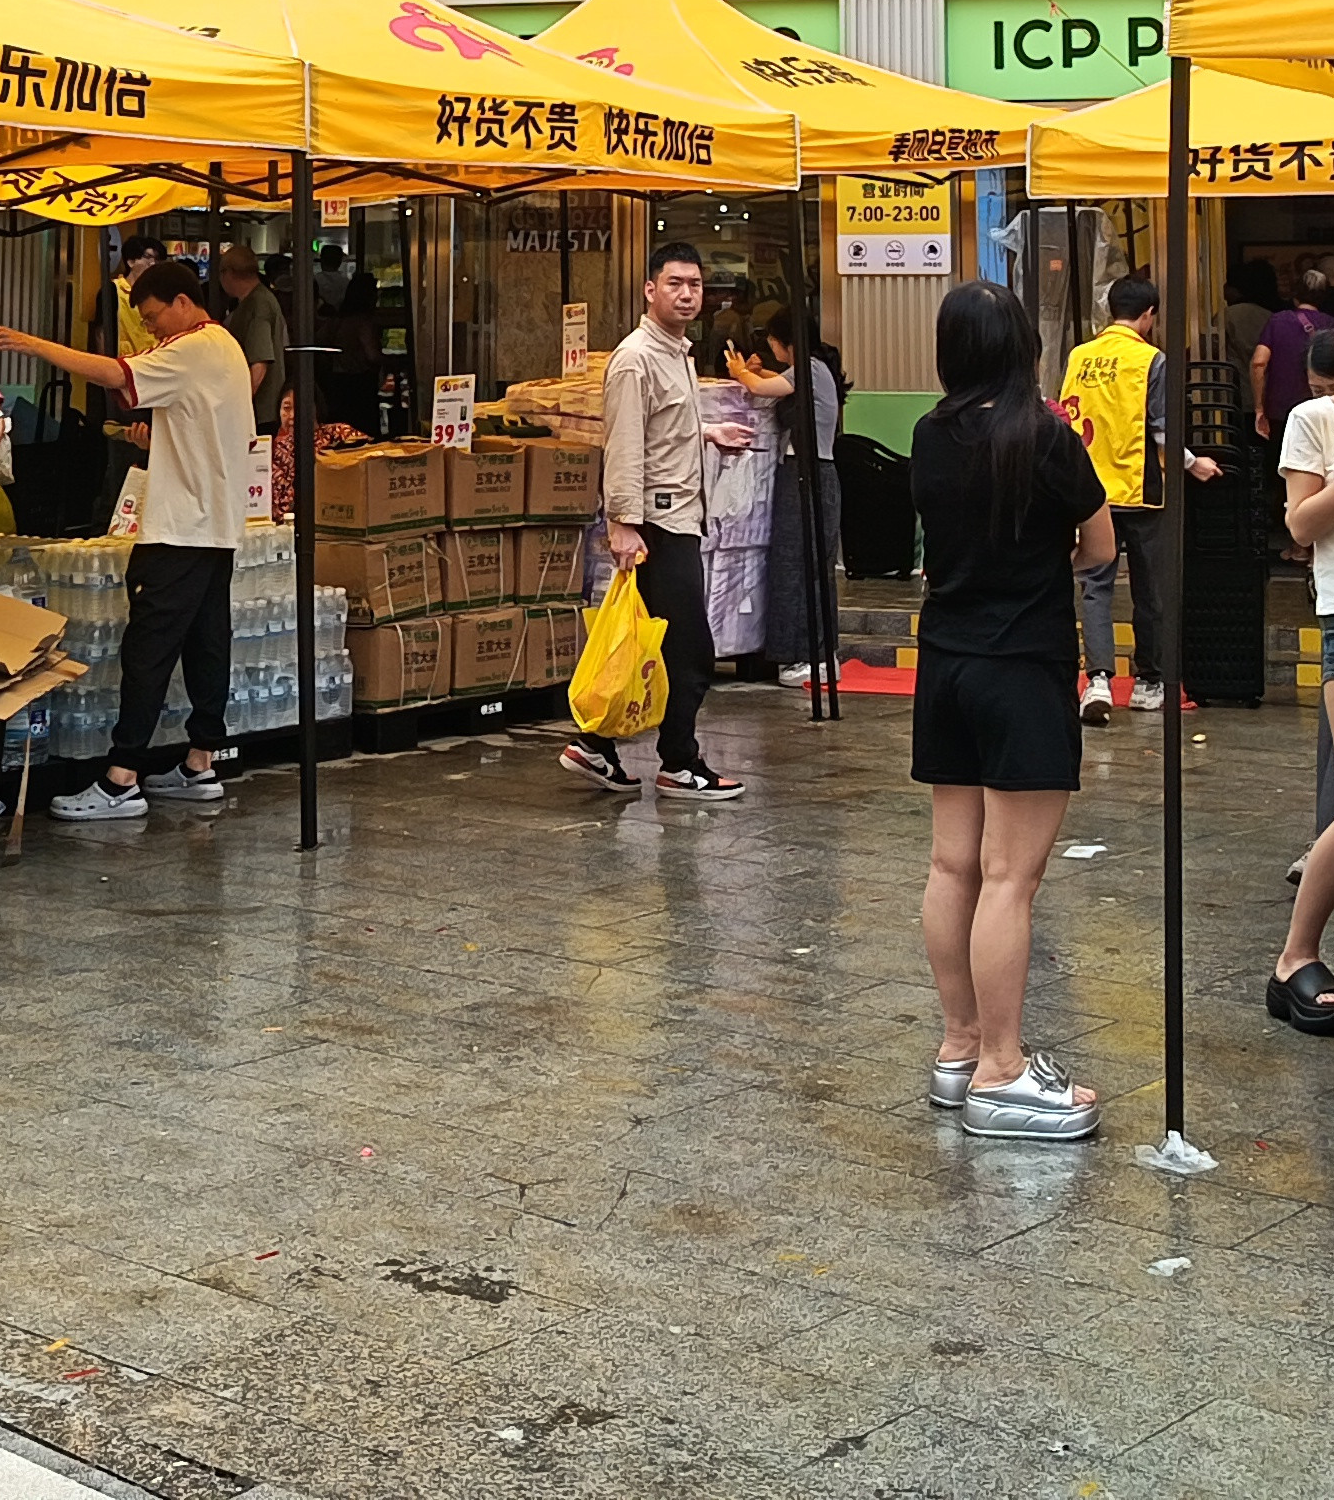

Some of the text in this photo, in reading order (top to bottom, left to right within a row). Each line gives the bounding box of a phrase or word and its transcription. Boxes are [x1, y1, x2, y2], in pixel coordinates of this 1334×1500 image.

[993, 17, 1101, 71] ICP
[436, 93, 715, 166] 好货不贵 快乐加倍
[888, 128, 1001, 164] 美团自营超市
[846, 205, 941, 222] 7:00-23:00
